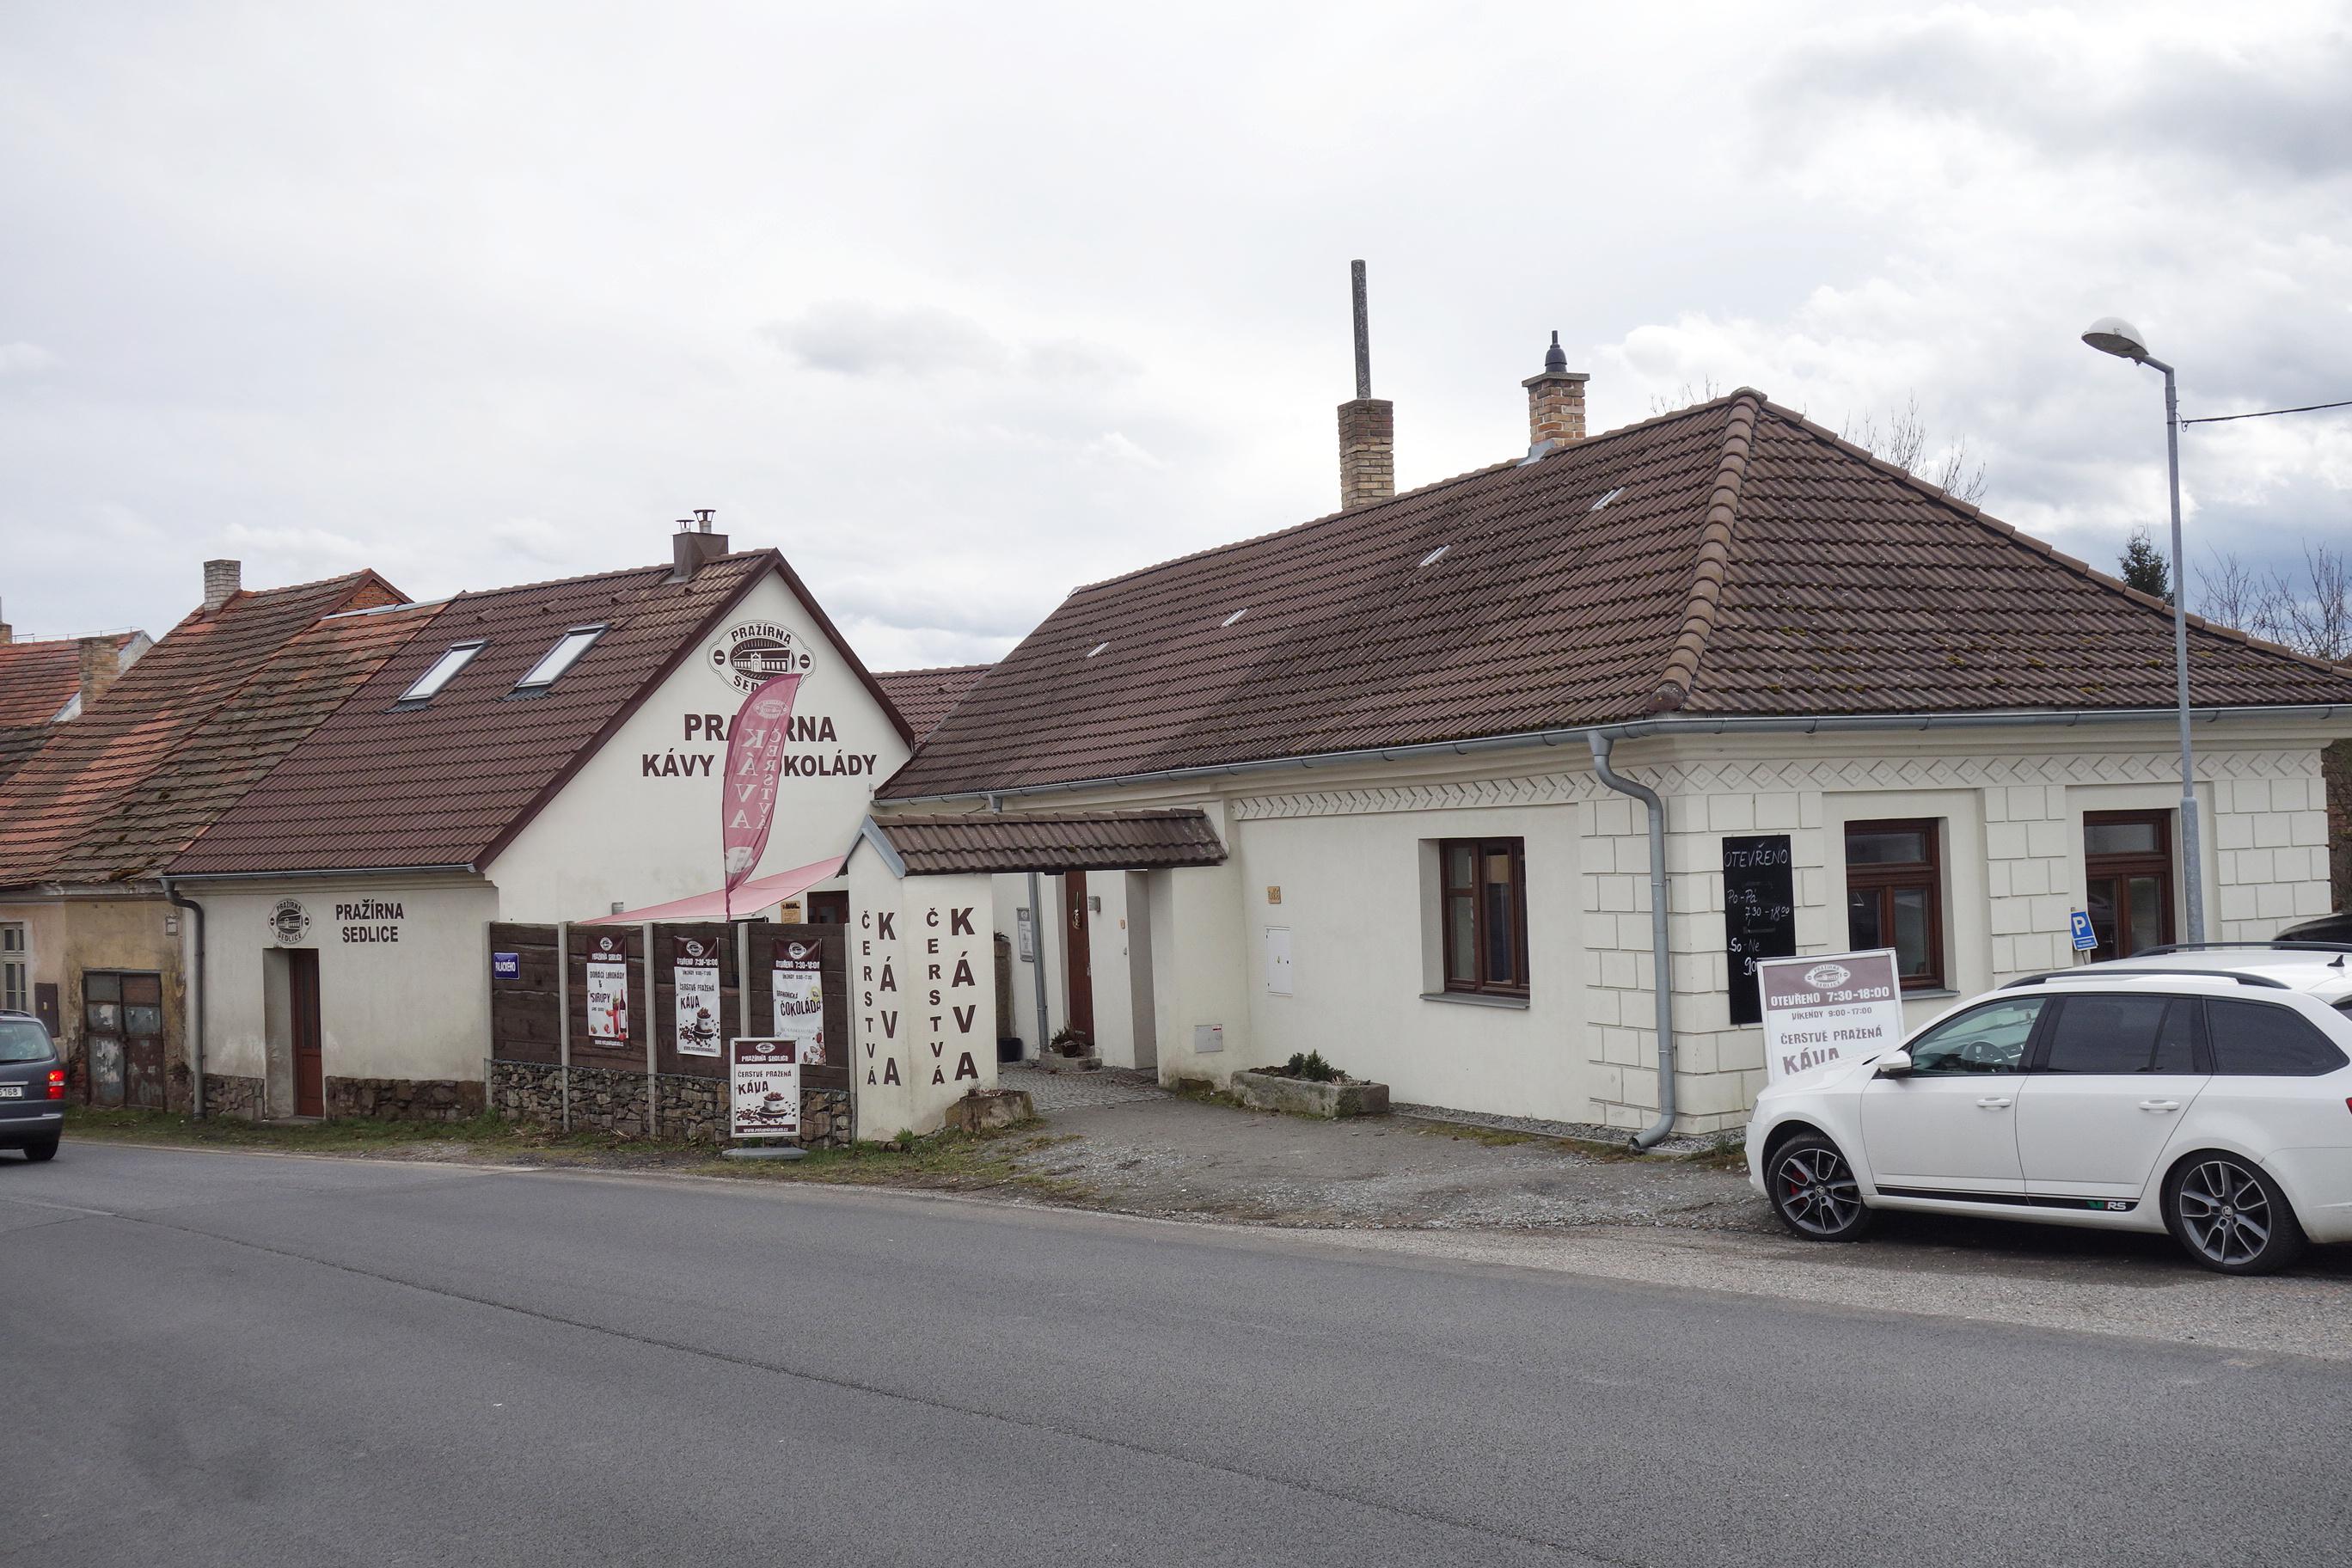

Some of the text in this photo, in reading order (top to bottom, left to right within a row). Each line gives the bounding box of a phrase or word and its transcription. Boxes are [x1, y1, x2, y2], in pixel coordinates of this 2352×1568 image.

[731, 623, 792, 644] PRAŽÍRNA
[684, 714, 837, 742] PRNA
[642, 748, 715, 777] KÁVY
[336, 898, 404, 921] PRAŽÍRNA
[342, 926, 399, 943] SEDLICE
[2073, 916, 2086, 935] P
[680, 993, 701, 1010] KÁVA
[861, 910, 877, 1086] ČERSTVÁ
[878, 911, 901, 1086] KÁVA
[926, 907, 945, 1086] ČERSTVÁ
[951, 907, 979, 1081] KÁVA
[1771, 986, 1890, 1007] OTEVŘENO 7:30-18:00
[780, 996, 822, 1017] ČOKOLÁDA
[1792, 1008, 1823, 1020] VÍKENDY
[1834, 1025, 1883, 1041] PRAŽENÁ
[1782, 1047, 1840, 1075] KÁVA
[738, 1080, 769, 1095] KÁVA
[2108, 1202, 2126, 1210] RS
